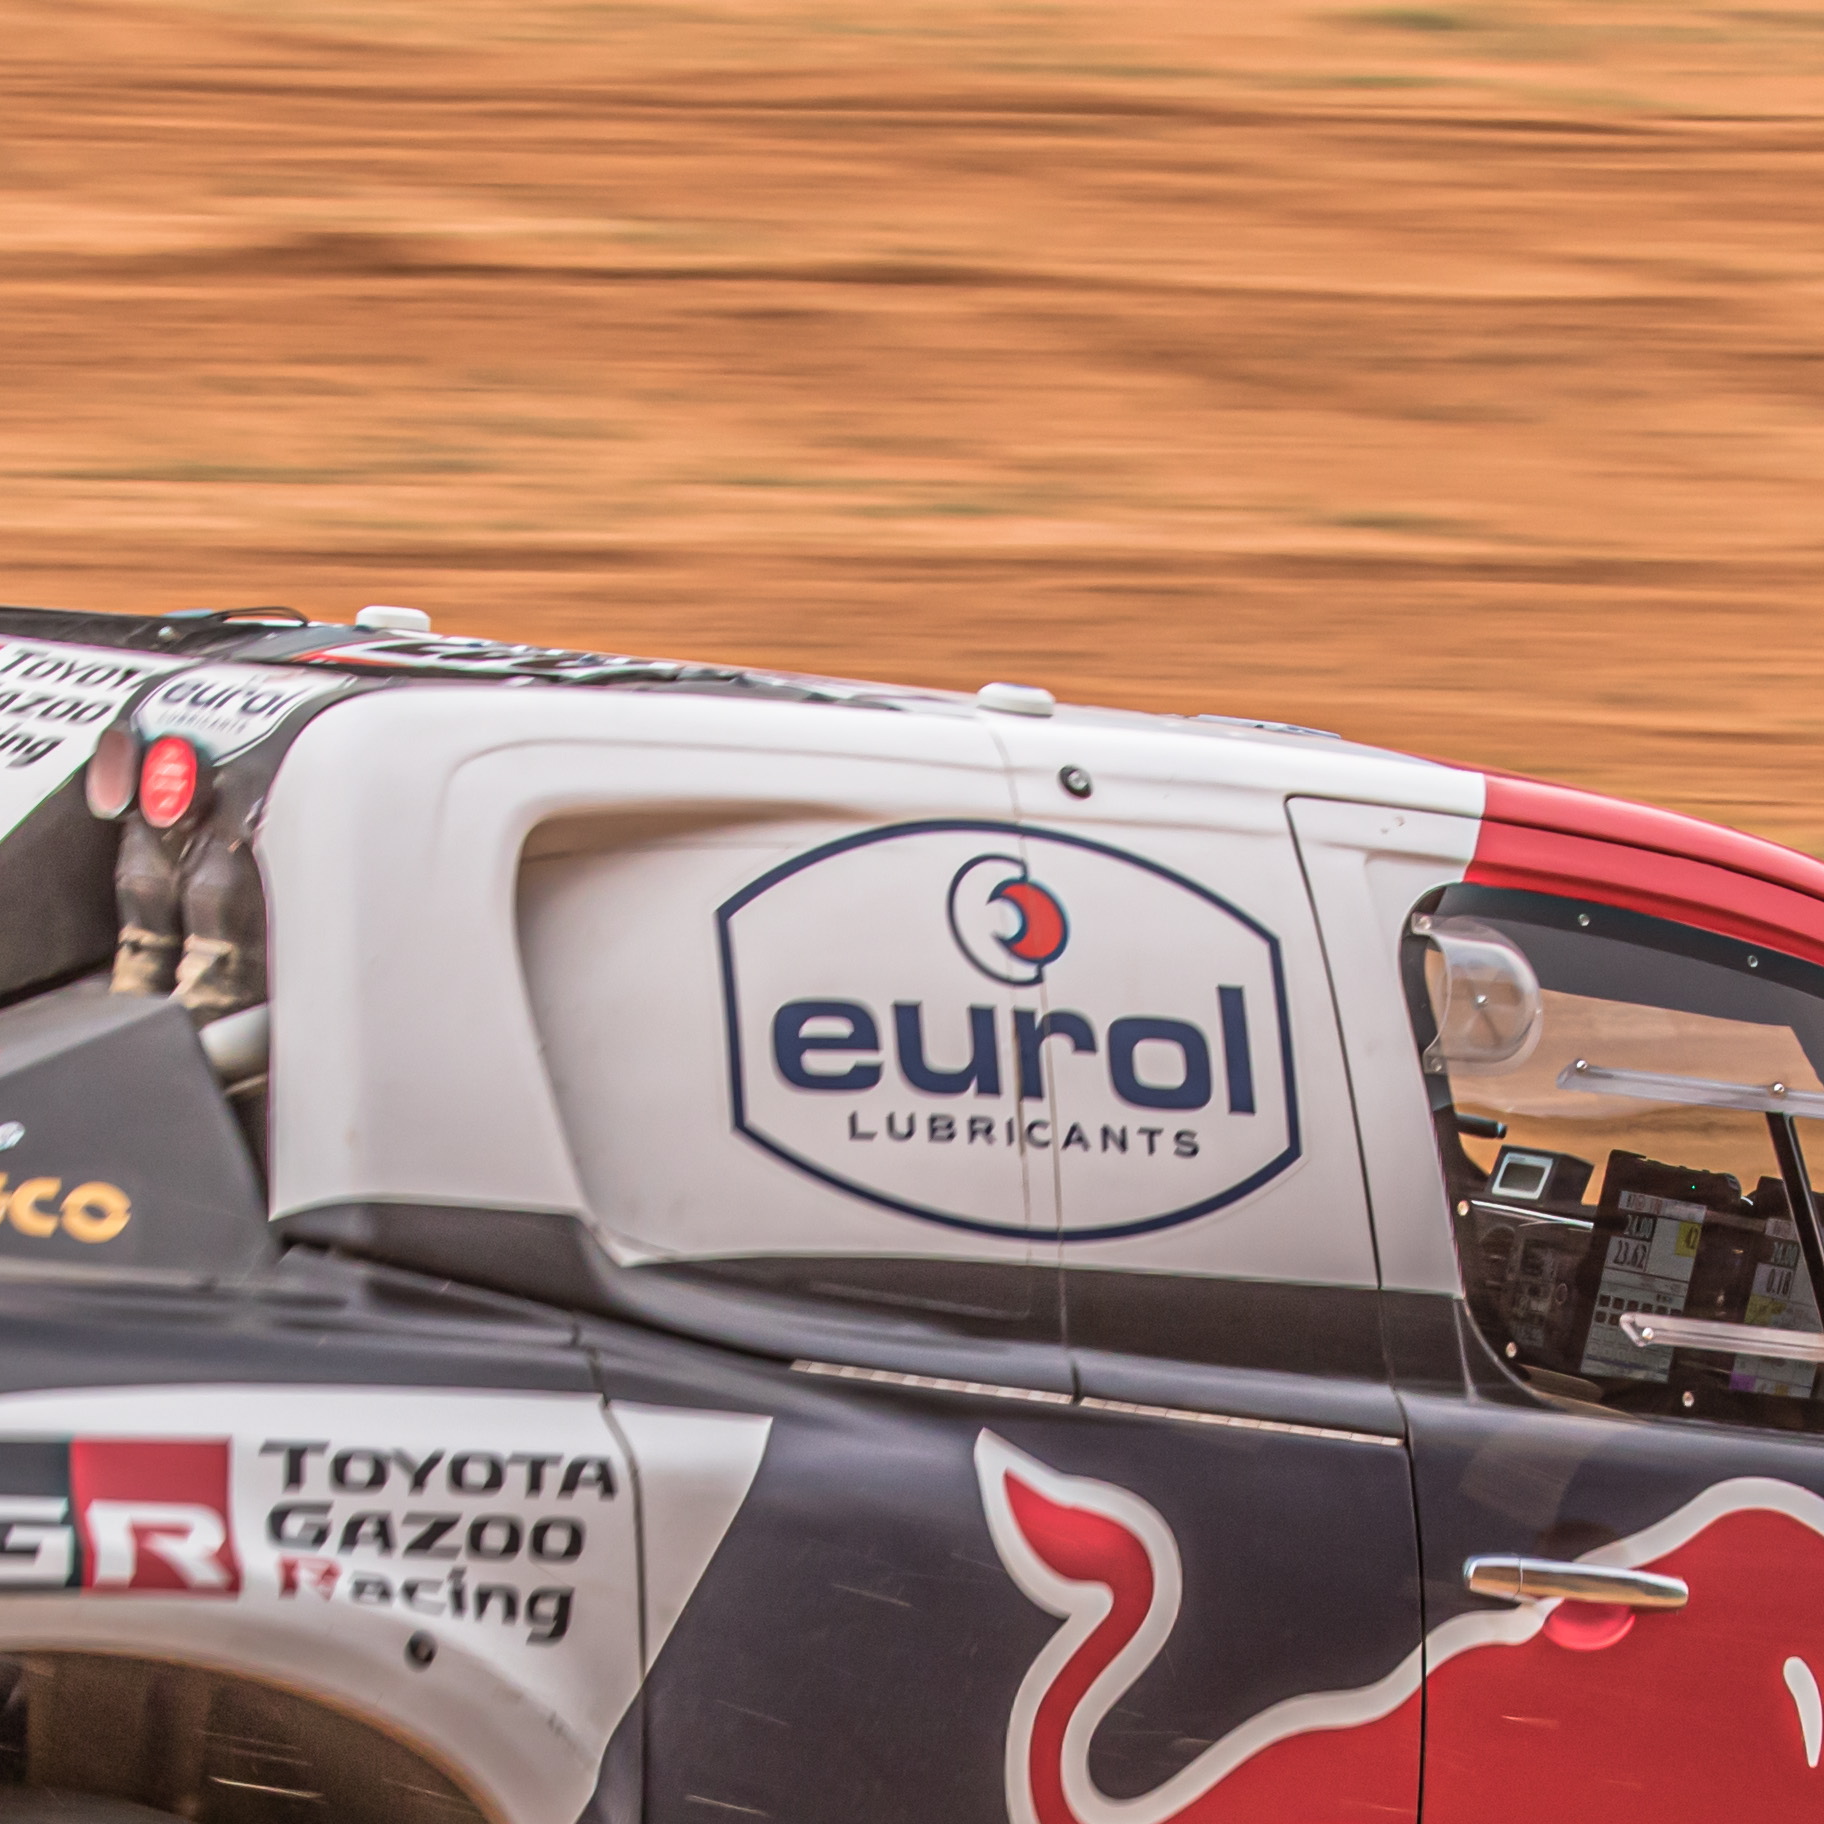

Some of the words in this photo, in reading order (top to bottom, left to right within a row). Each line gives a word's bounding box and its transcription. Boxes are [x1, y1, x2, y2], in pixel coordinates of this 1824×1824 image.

[162, 680, 315, 718] eurol
[773, 984, 1256, 1115] eurol
[847, 1109, 1202, 1158] LUBRICANTS
[259, 1440, 618, 1501] TOYOTA
[266, 1501, 587, 1563] GAZOO
[277, 1556, 576, 1645] Racing
